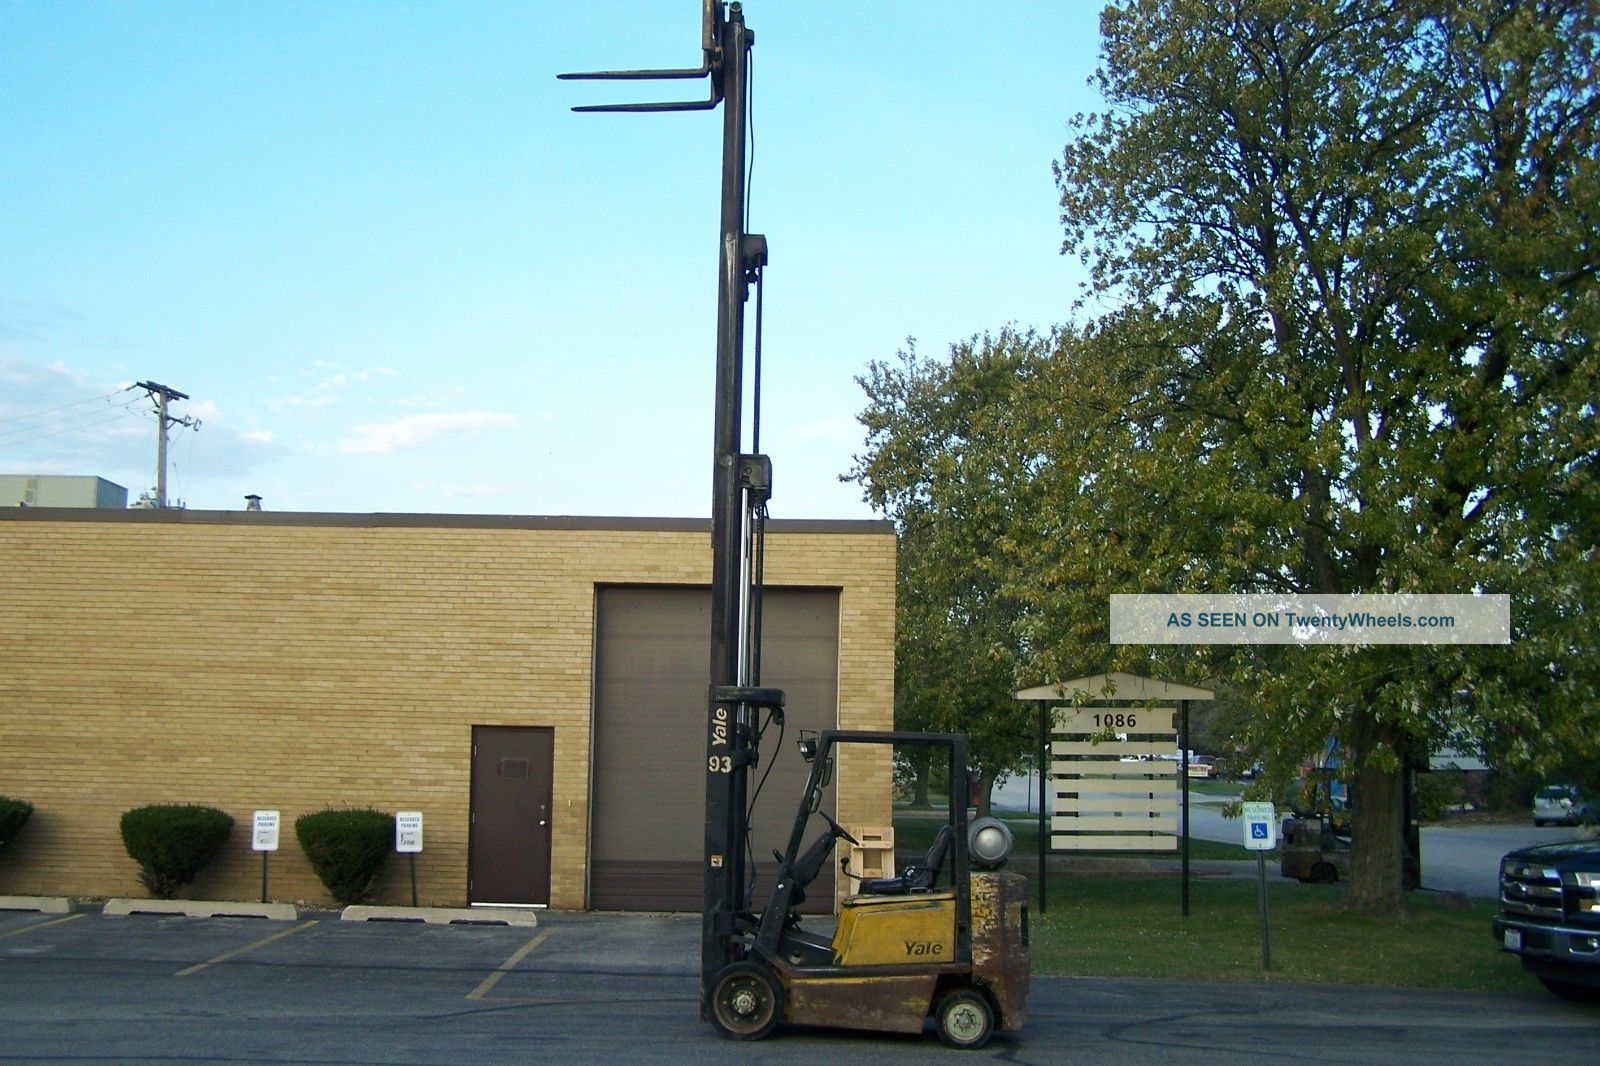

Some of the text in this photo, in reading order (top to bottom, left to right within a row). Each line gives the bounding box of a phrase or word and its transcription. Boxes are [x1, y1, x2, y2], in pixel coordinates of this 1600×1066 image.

[712, 707, 728, 746] Yale
[1093, 713, 1137, 728] 1086
[708, 755, 732, 773] 93
[904, 941, 943, 956] Yale
